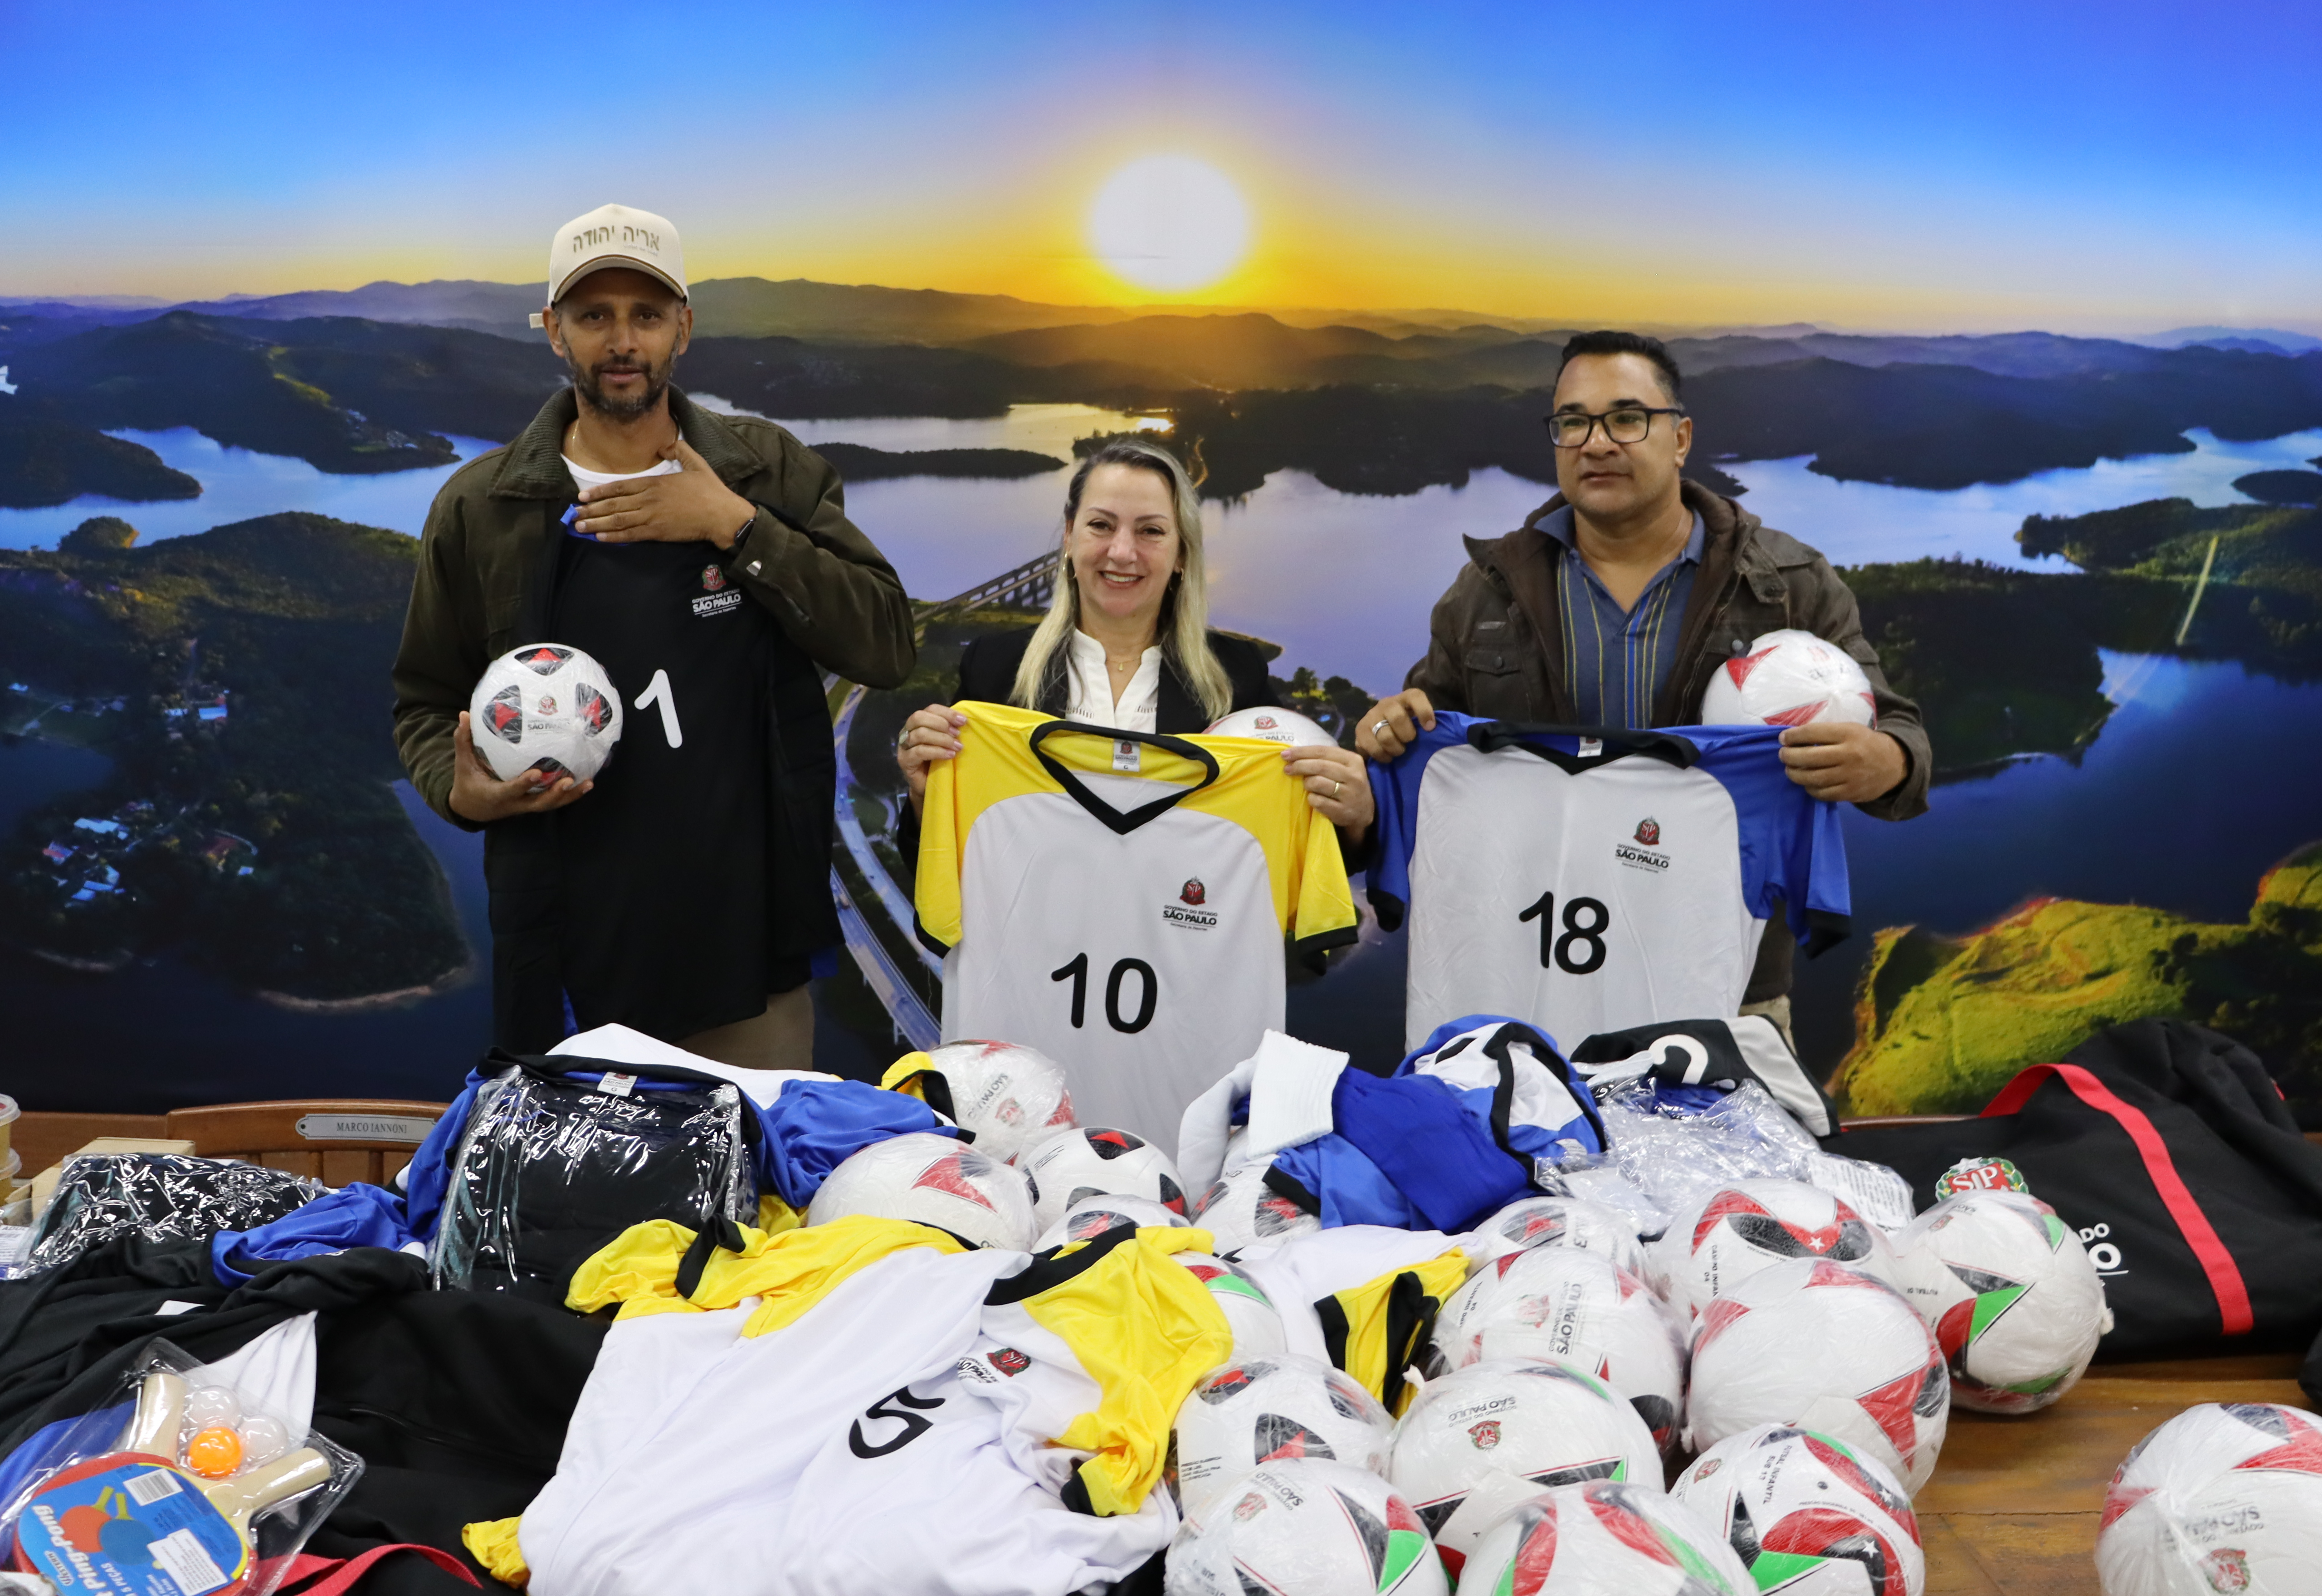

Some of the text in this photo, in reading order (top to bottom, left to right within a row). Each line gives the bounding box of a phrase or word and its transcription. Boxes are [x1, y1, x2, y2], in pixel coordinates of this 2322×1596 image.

[573, 225, 614, 253] יהודה
[624, 226, 659, 251] אריה
[713, 594, 741, 608] PAULO
[634, 669, 683, 749] 1
[1637, 854, 1669, 868] PAULO
[1185, 914, 1217, 925] PAULO
[1518, 891, 1610, 975] 18
[1051, 952, 1158, 1034] 10
[337, 1122, 407, 1134] MARCO IANNONI
[1464, 1281, 1483, 1310] INFANTIL
[1563, 1283, 1582, 1323] PAULO
[848, 1385, 946, 1460] 5
[1449, 1403, 1487, 1421] PAULO
[1763, 1467, 1781, 1505] INFANTIL
[31, 1504, 107, 1590] Ping-Pong
[101, 1562, 127, 1586] PEÇAS
